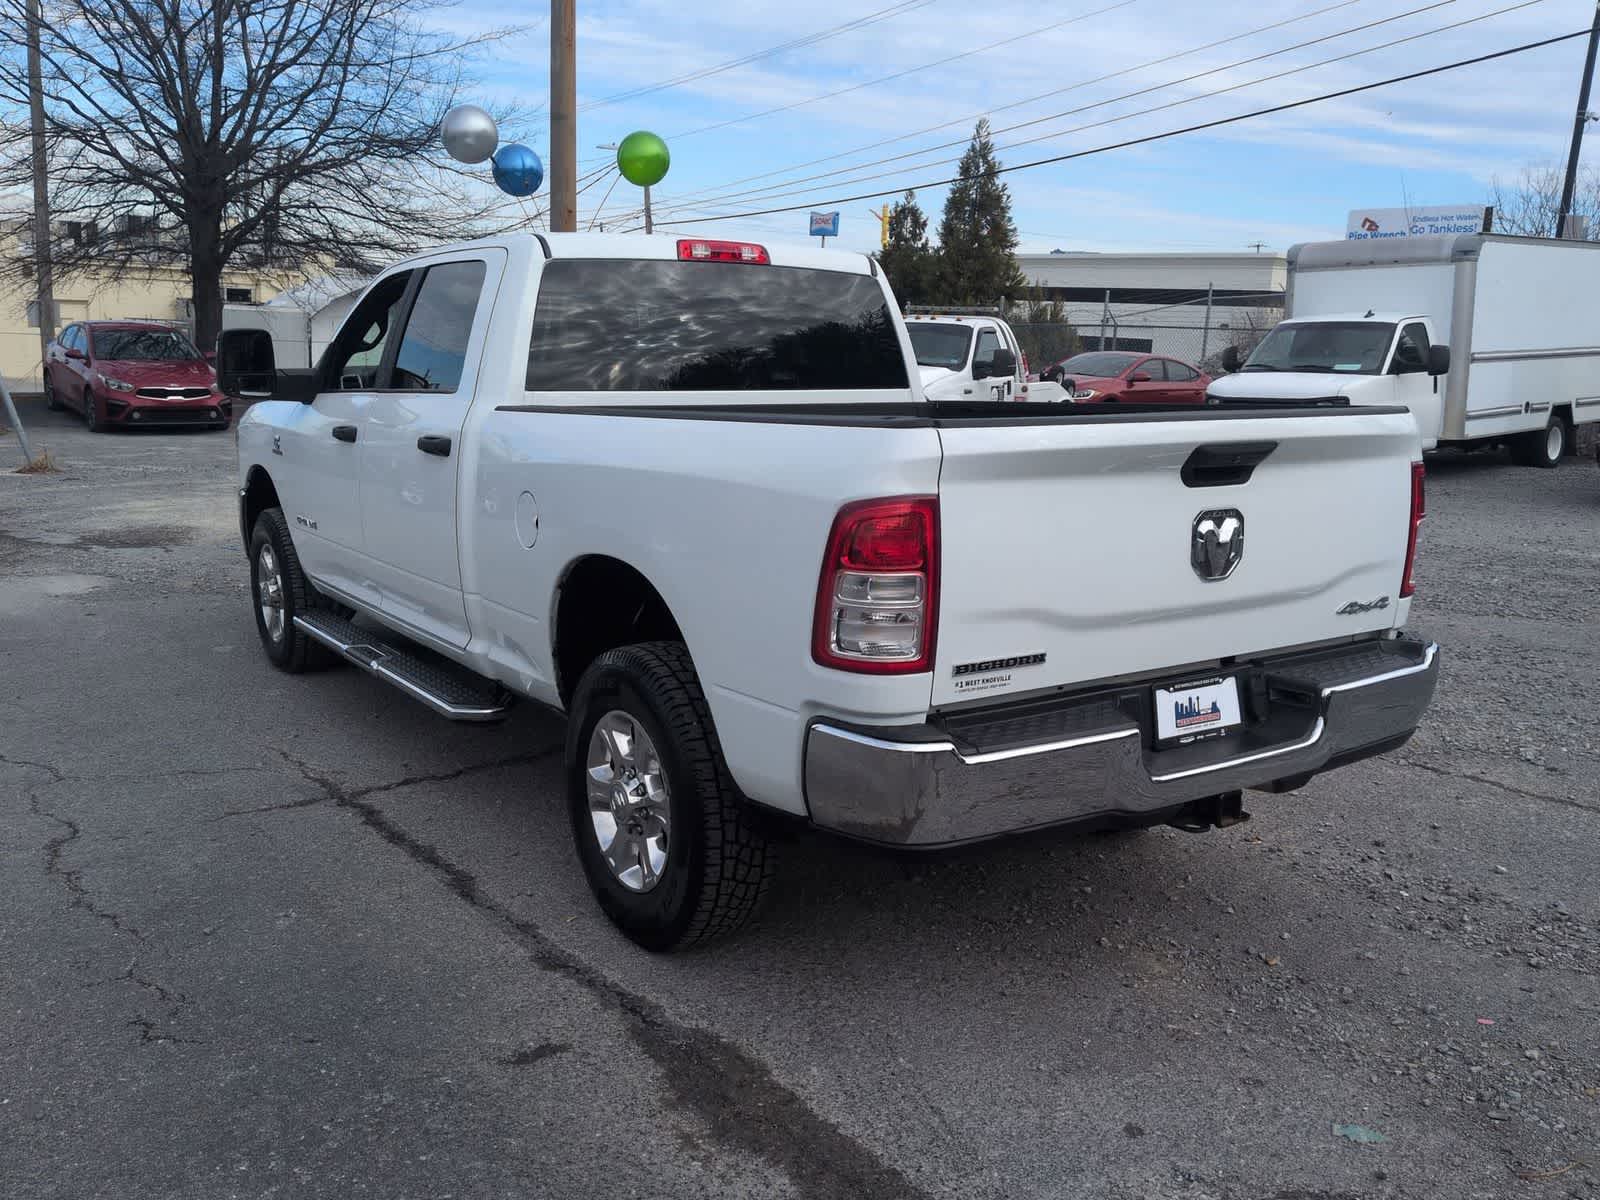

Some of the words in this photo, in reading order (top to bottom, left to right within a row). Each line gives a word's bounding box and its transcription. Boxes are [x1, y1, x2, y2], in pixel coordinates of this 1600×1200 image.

[1410, 224, 1425, 234] Go
[1427, 222, 1477, 234] Tankless!
[1348, 231, 1368, 240] Pipe
[1370, 230, 1407, 239] Wrench
[964, 679, 981, 687] WEST
